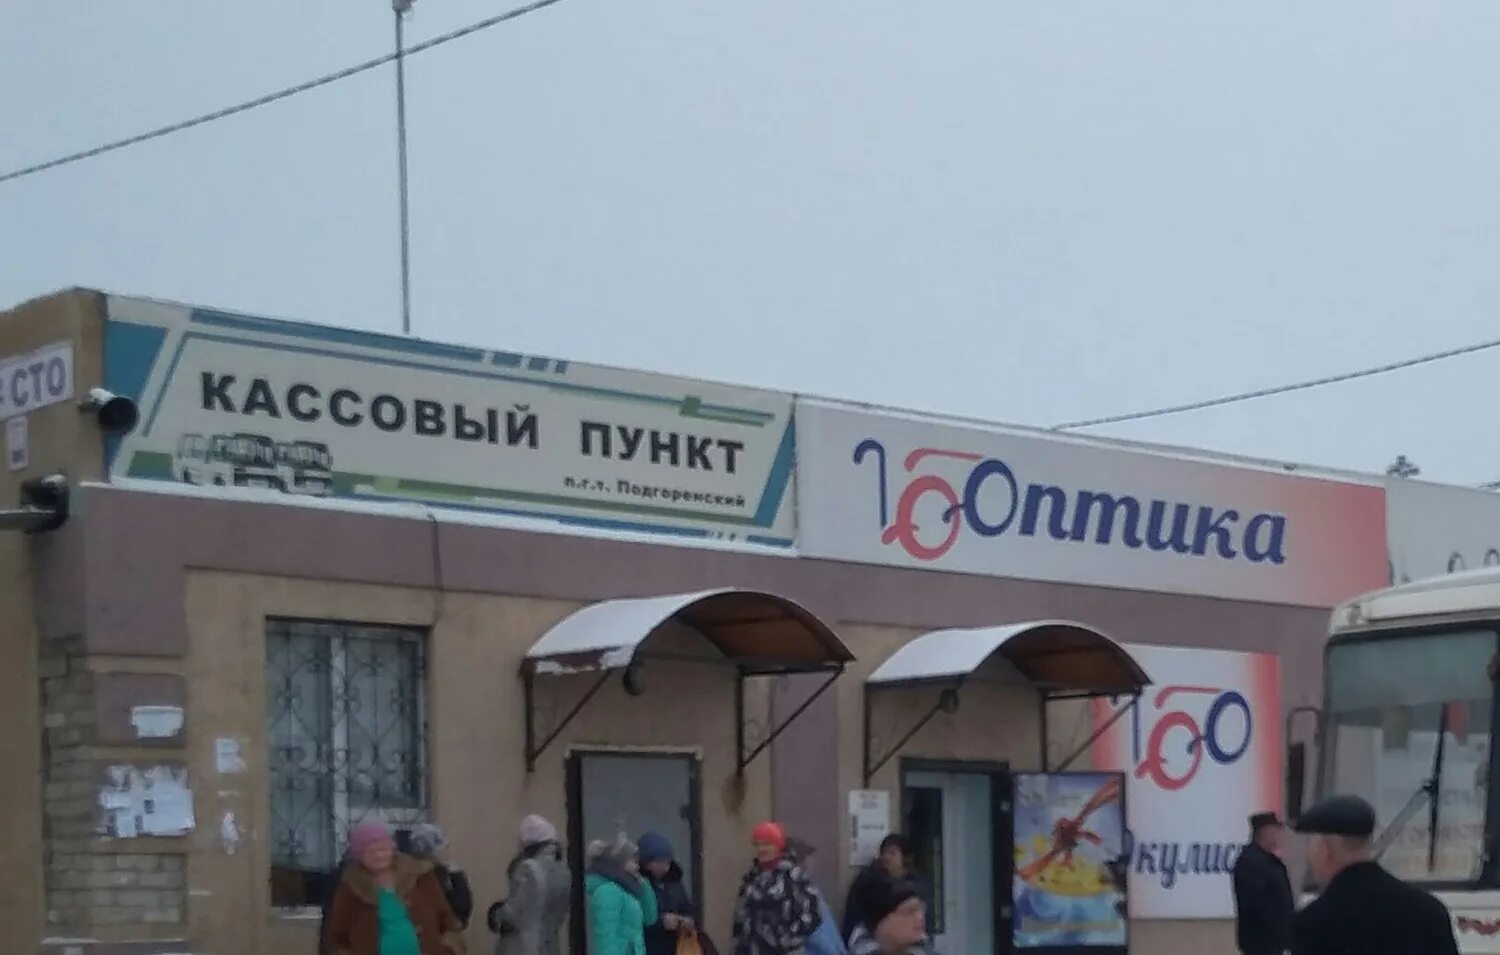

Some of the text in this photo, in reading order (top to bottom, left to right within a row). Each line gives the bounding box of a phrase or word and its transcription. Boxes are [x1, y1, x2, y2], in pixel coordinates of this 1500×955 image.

[201, 371, 744, 474] КАССОВЫЙ ПУНКТ
[616, 479, 746, 507] Подгоренский
